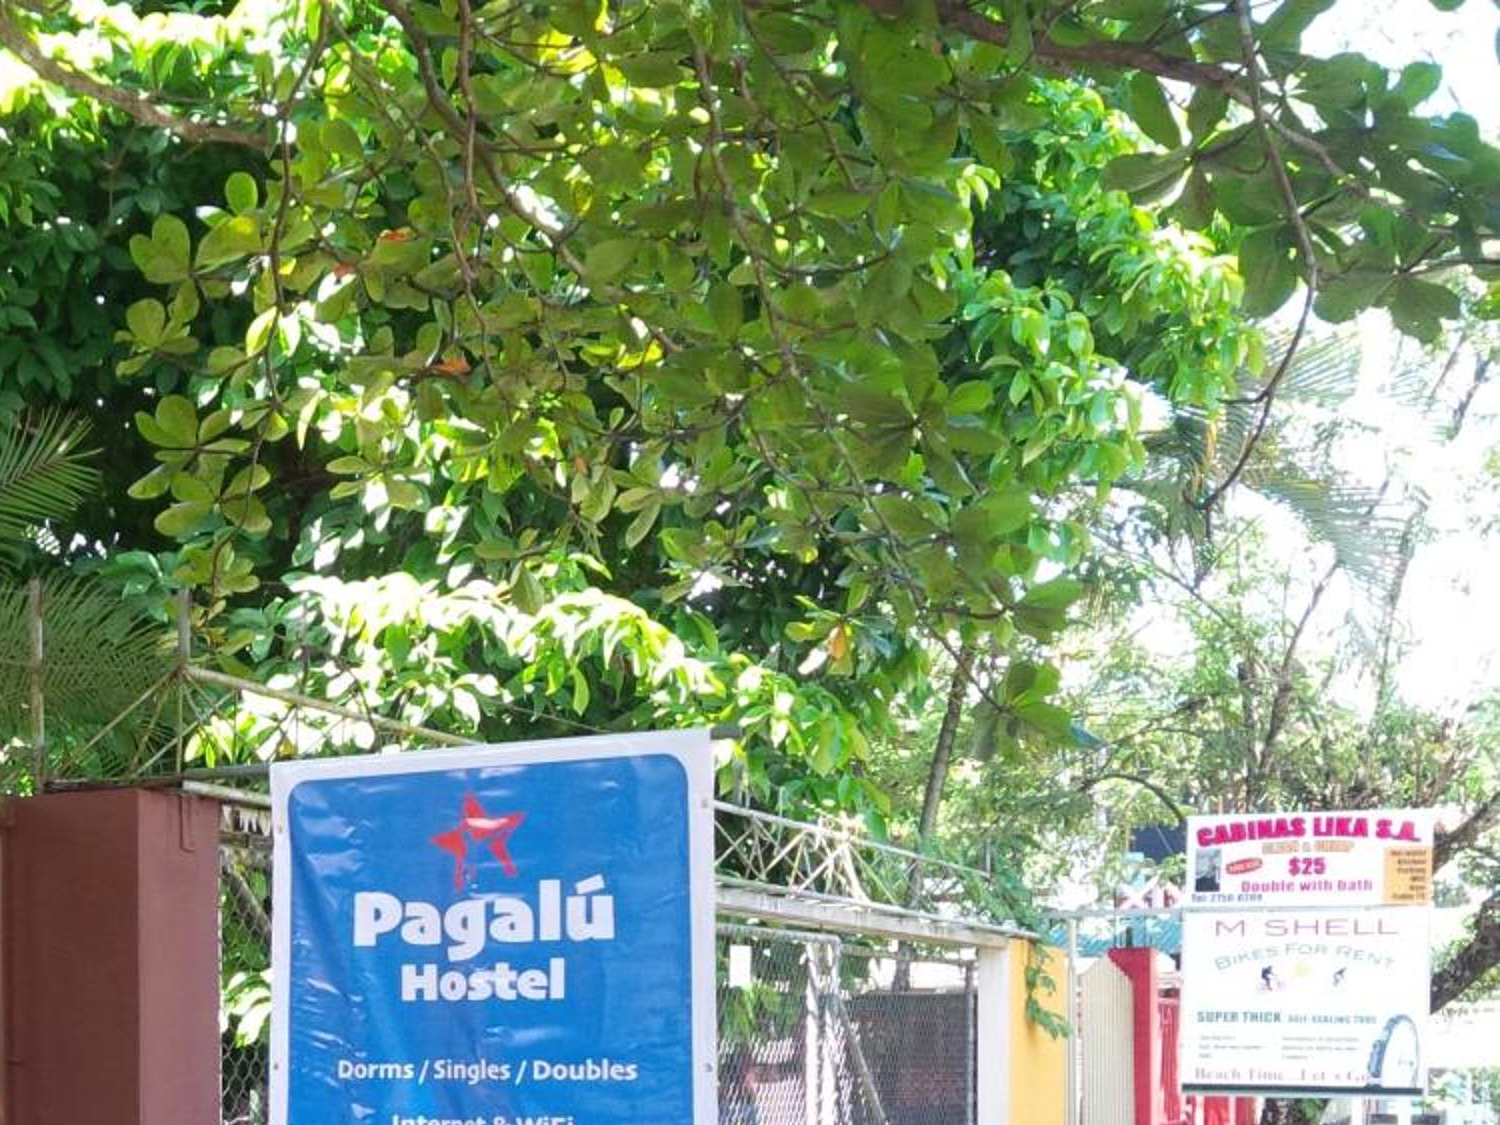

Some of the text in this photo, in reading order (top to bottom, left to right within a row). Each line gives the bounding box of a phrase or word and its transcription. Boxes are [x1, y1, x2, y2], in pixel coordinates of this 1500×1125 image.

[1196, 817, 1306, 847] CABINAS
[1288, 856, 1326, 876] $25
[1241, 880, 1295, 892] Double
[1300, 880, 1333, 892] with
[352, 874, 616, 962] Pagalú
[1215, 917, 1399, 937] M SHELL
[1214, 941, 1396, 971] BIKES FOR RENT
[401, 957, 565, 1001] Hostel
[1196, 1011, 1239, 1023] SUPER
[1242, 1011, 1282, 1024] THICK
[338, 1058, 414, 1081] Dorms
[433, 1059, 511, 1086] Singles
[533, 1058, 638, 1081] Doubles
